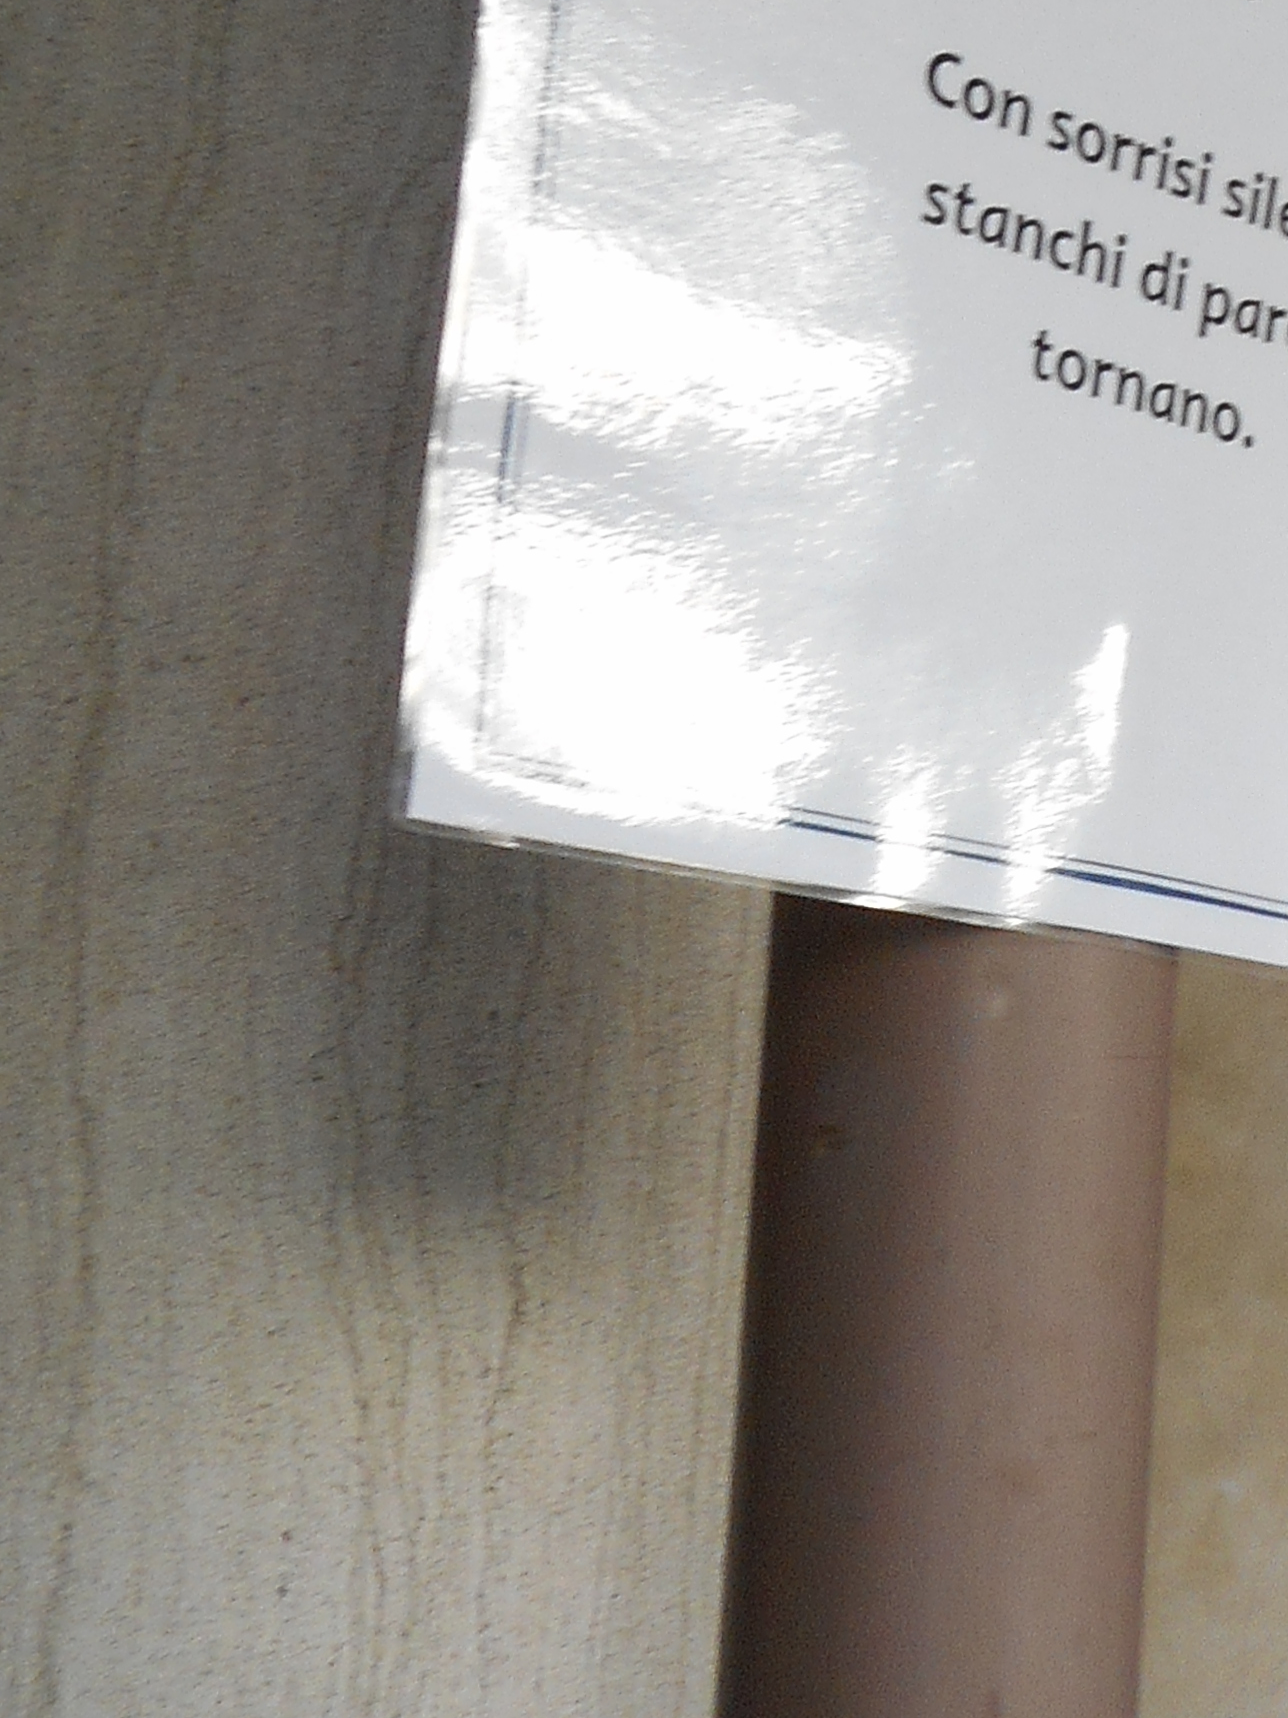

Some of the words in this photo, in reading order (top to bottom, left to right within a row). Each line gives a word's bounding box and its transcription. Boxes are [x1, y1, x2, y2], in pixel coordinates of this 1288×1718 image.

[926, 51, 1033, 137] Con
[1046, 109, 1214, 206] sorrisi
[921, 182, 1128, 289] stanchi
[1139, 250, 1190, 311] di
[1032, 329, 1254, 449] tornano.
